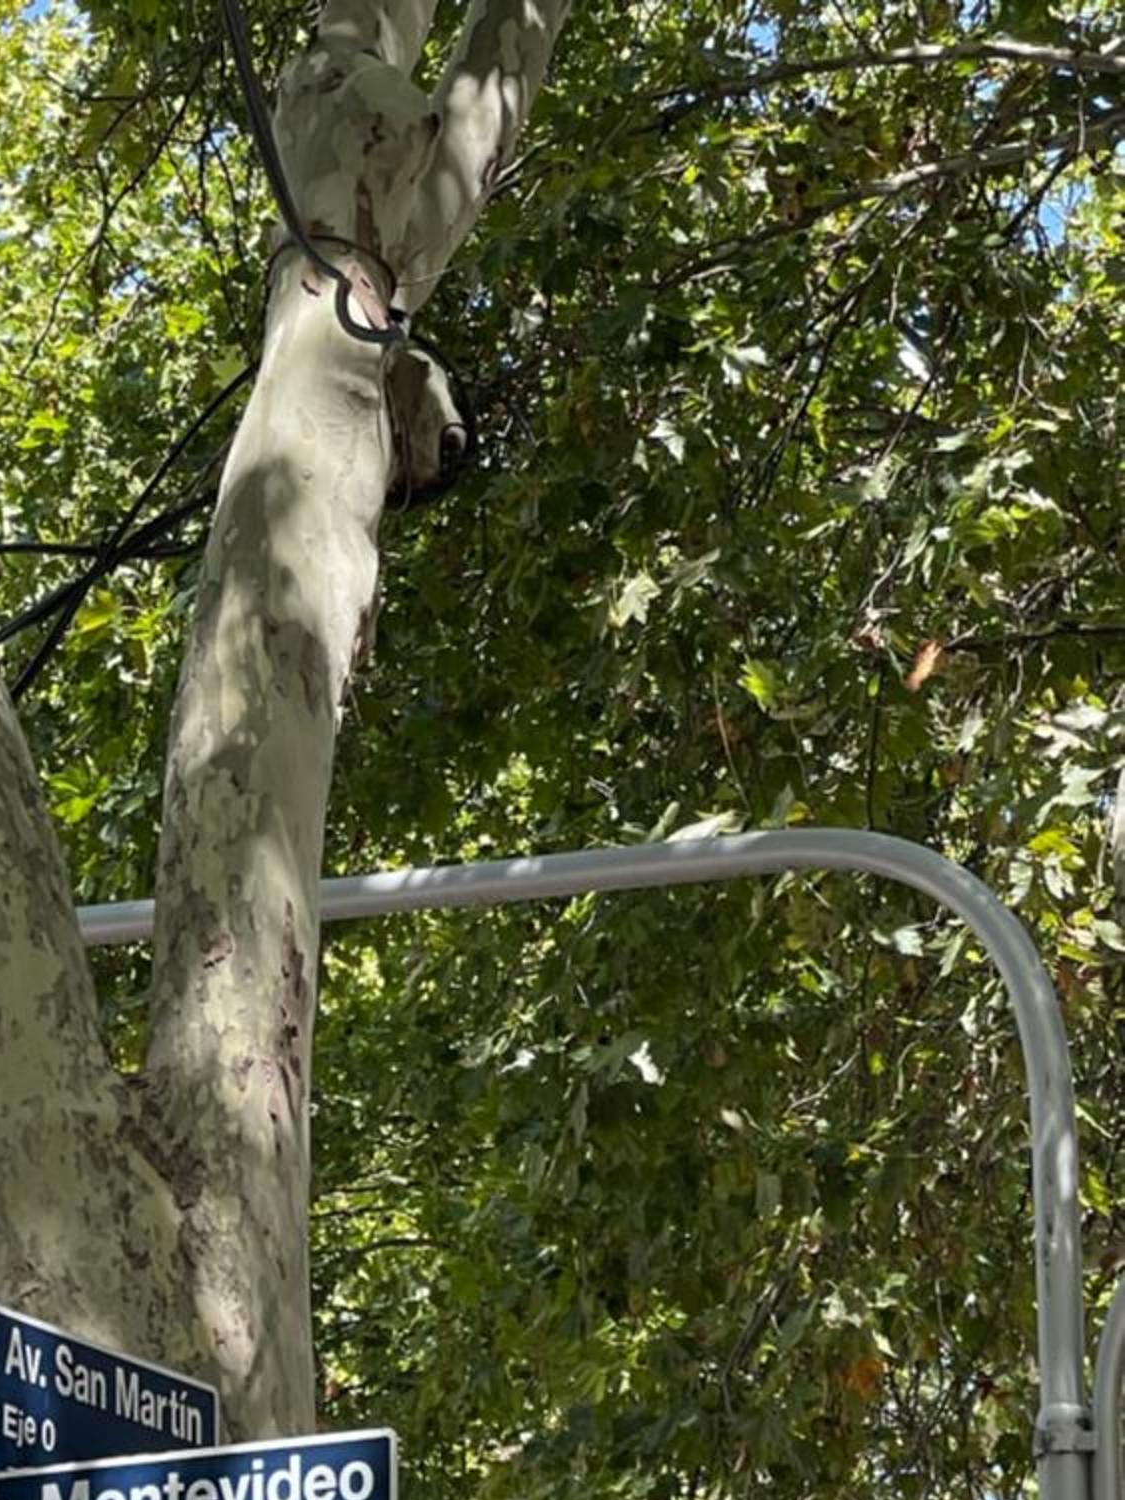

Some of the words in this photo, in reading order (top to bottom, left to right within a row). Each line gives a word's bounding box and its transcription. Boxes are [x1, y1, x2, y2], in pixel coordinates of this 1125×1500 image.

[2, 1402, 36, 1448] Eje
[41, 1418, 57, 1451] 0
[4, 1327, 47, 1388] Av.
[55, 1345, 107, 1410] San
[115, 1366, 203, 1445] Martín
